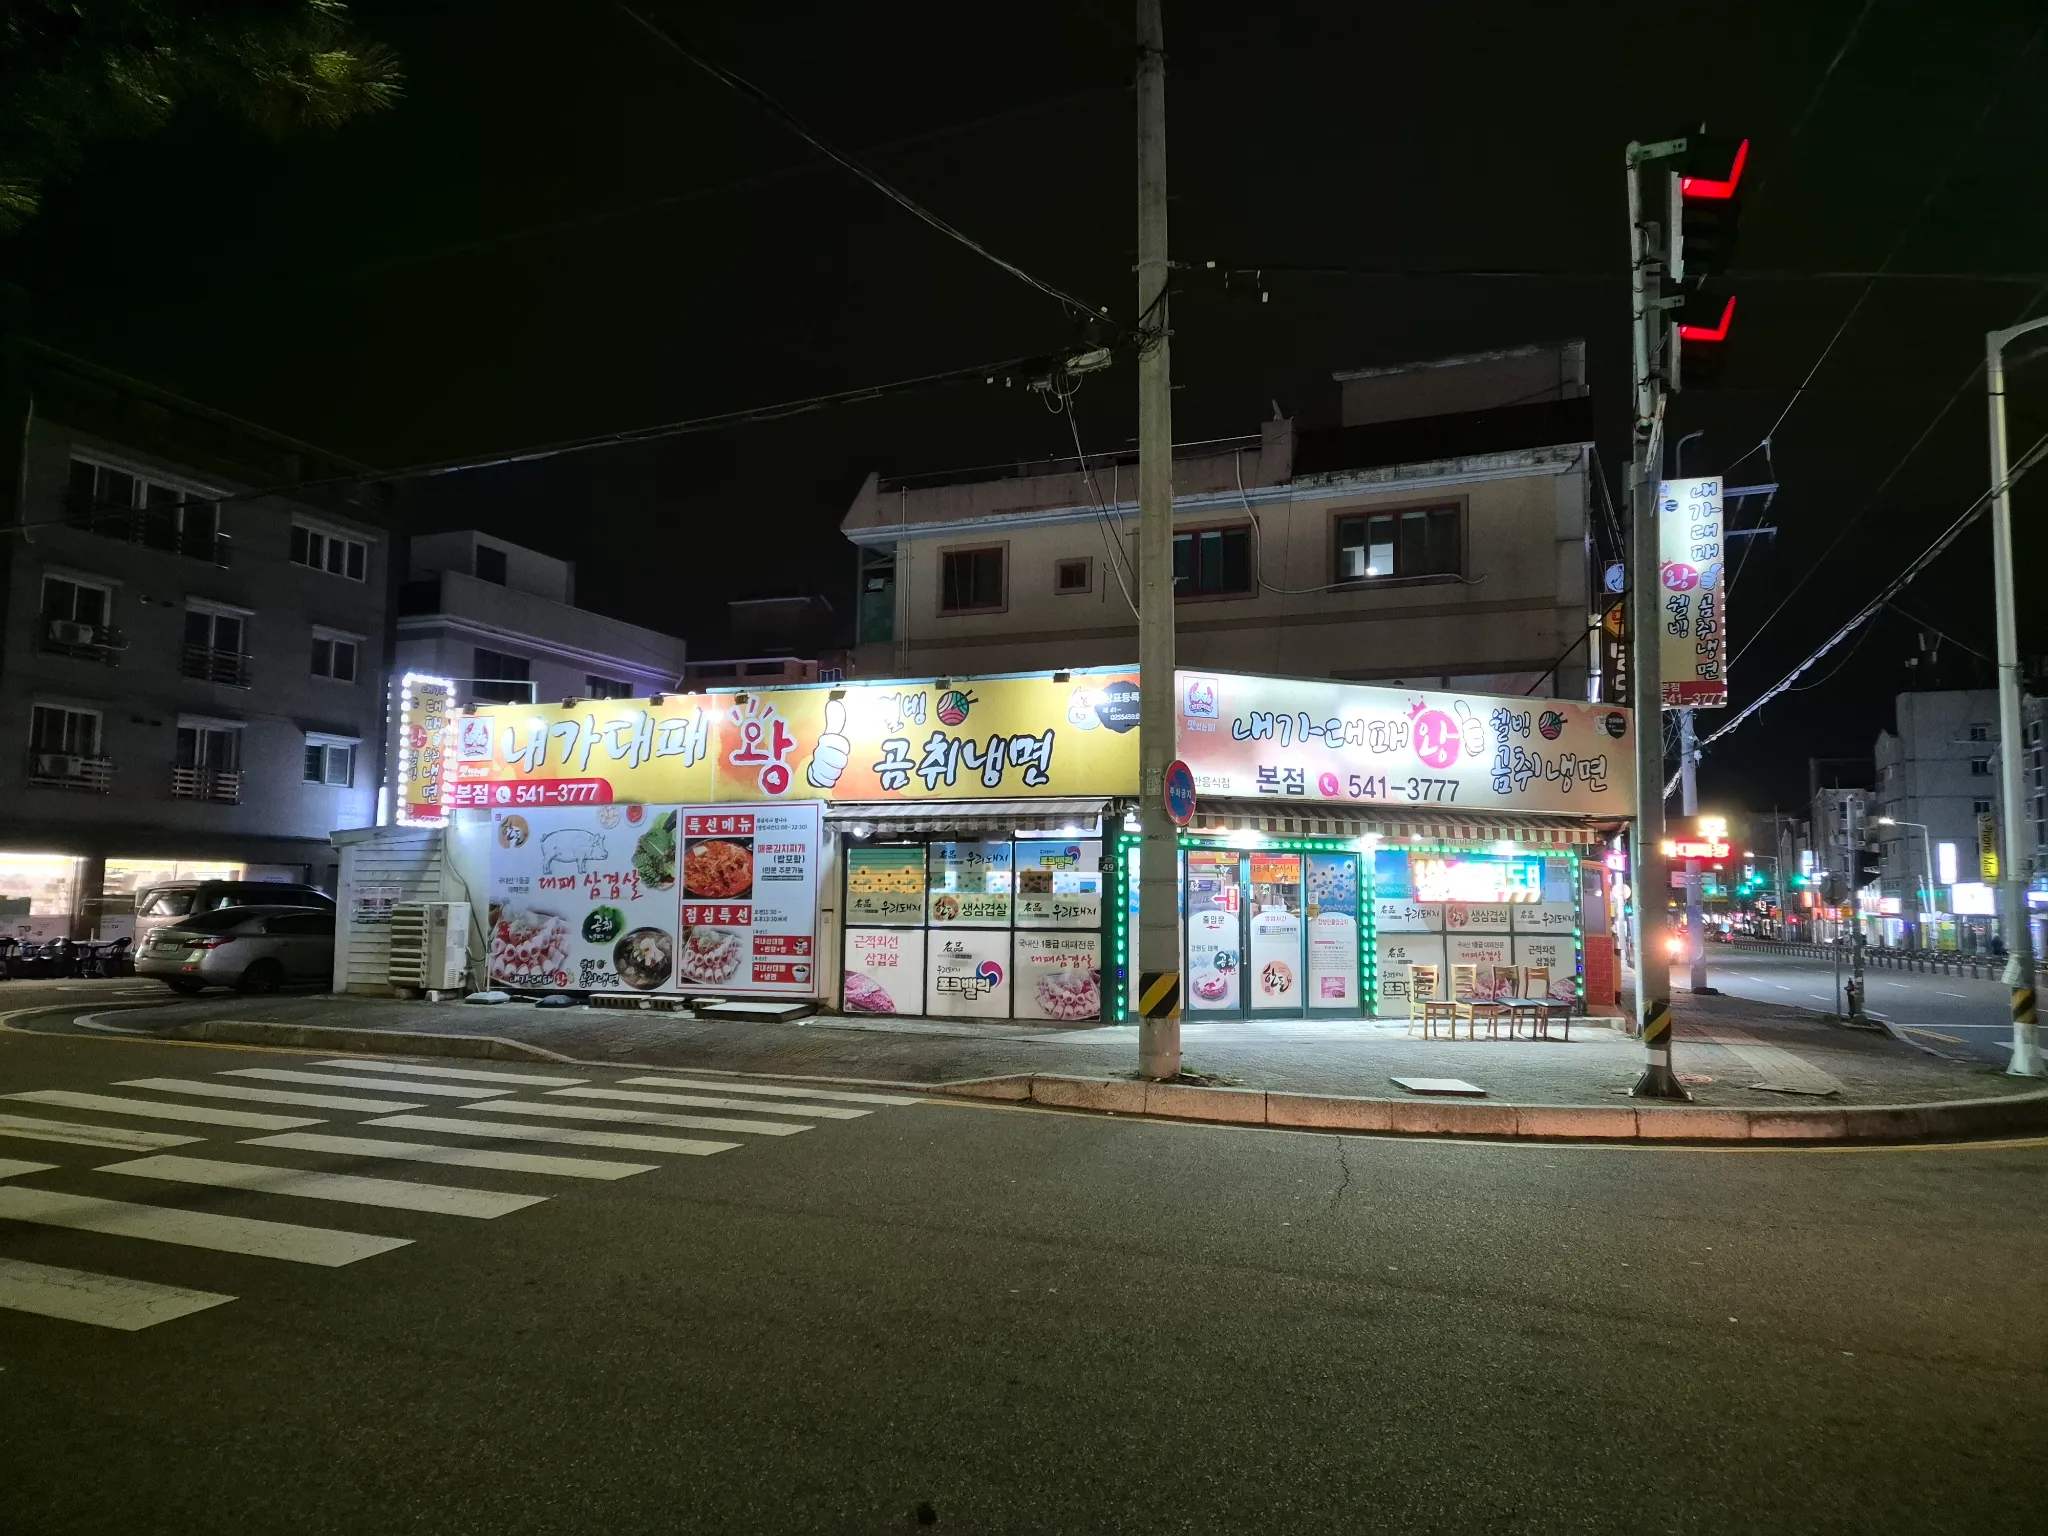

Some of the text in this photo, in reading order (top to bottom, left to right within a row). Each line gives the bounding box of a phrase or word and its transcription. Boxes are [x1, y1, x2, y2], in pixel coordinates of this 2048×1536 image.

[1664, 572, 1698, 590] 왕
[1489, 707, 1532, 743] 웰빙
[1232, 710, 1461, 764] 내가대패 왕
[502, 707, 798, 796] 내가대패 왕
[872, 730, 1055, 791] 곰취냉면
[1490, 744, 1608, 795] 곰취냉면
[1195, 775, 1231, 789] 반음식점
[1256, 765, 1460, 802] 본점 541-3777
[455, 783, 599, 805] 본점 541-3777
[1169, 786, 1192, 799] 주차금지
[688, 817, 752, 834] 특선메뉴
[538, 875, 576, 890] 대패
[685, 906, 749, 924] 점심특선
[881, 901, 922, 918] 우리돼지
[961, 902, 1008, 917] 생삼겹살
[1052, 904, 1097, 921] 우리돼지
[1471, 910, 1508, 923] 생삼겹살
[854, 935, 899, 949] 근적외선
[1018, 939, 1096, 950] 국내산 1등급 대패전문
[864, 952, 899, 967] 삼겹살
[937, 976, 991, 1000] 포크밸리
